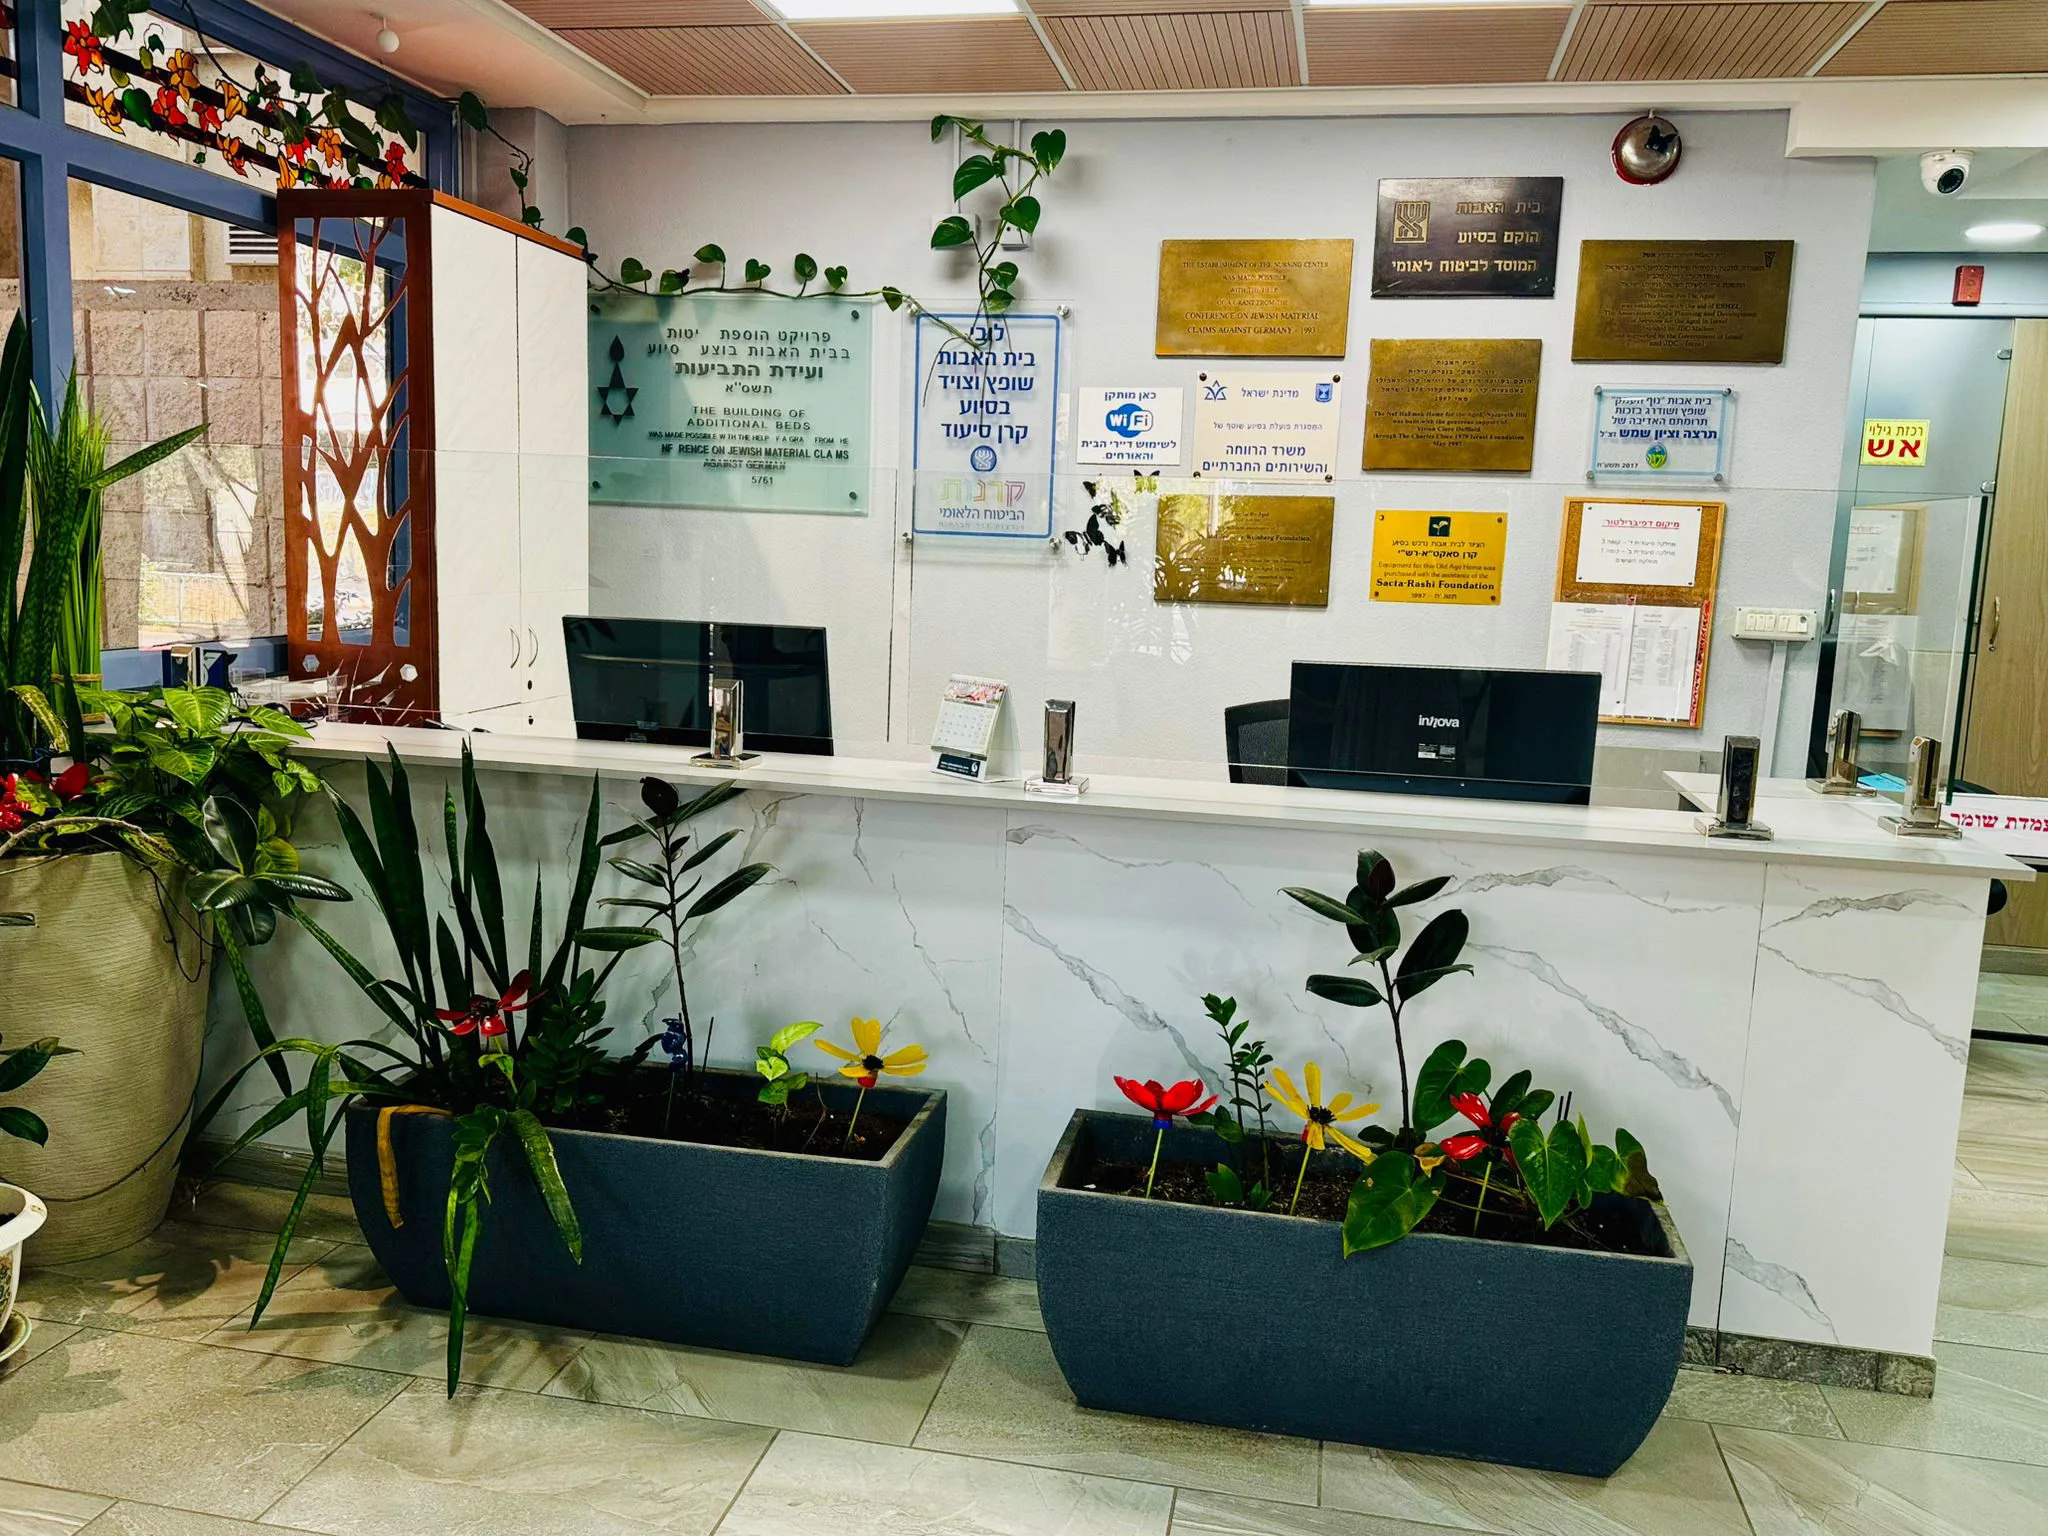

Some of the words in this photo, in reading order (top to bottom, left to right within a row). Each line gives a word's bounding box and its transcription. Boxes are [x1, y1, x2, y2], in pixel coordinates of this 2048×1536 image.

[1456, 202, 1504, 214] האבות
[1515, 202, 1541, 213] בית
[1458, 232, 1497, 243] בסיוע
[1504, 232, 1540, 244] הוקם
[1392, 260, 1432, 272] לאומי
[1439, 259, 1488, 272] לביטוח
[1494, 260, 1537, 271] המוסד
[1185, 312, 1235, 320] CONFERENCE
[1237, 312, 1248, 320] ON
[1250, 312, 1278, 320] JEWISH
[1281, 312, 1319, 320] MATERIAL
[667, 328, 698, 339] יטות
[720, 328, 769, 342] הוספת
[778, 331, 831, 345] פרויקט
[648, 344, 679, 355] סיוע
[701, 344, 738, 356] בוצע
[748, 346, 799, 358] האבות
[810, 348, 850, 359] בבית
[938, 351, 996, 366] האבות
[1003, 351, 1035, 366] בית
[675, 362, 760, 377] התביעות
[769, 364, 823, 379] ועידת
[725, 382, 772, 394] תשס"א
[938, 375, 980, 390] וצויד
[986, 375, 1034, 394] שופץ
[1105, 391, 1136, 402] מותקן
[1138, 392, 1156, 401] כאן
[1241, 387, 1269, 398] ישראל
[1272, 388, 1299, 398] מדינת
[1667, 397, 1692, 405] אבות
[1695, 397, 1712, 405] בית
[693, 406, 716, 415] THE
[724, 407, 782, 417] BUILDING
[789, 409, 806, 418] OF
[960, 400, 1010, 415] בסיוע
[1615, 407, 1642, 415] בזכות
[1645, 407, 1678, 415] ושודרג
[1681, 408, 1706, 416] שופץ
[687, 418, 768, 429] ADDITIONAL
[776, 421, 811, 430] BEDS
[1213, 421, 1223, 429] של
[1612, 416, 1626, 425] של
[1629, 417, 1666, 425] האדיבה
[1669, 418, 1708, 426] תרומתם
[941, 423, 991, 438] סיעוד
[998, 425, 1028, 443] קרן
[1620, 429, 1651, 438] שמש
[1654, 430, 1679, 440] וציון
[1683, 430, 1717, 439] תרצה
[1870, 423, 1891, 436] גילוי
[1896, 426, 1923, 436] רכזת
[665, 431, 684, 439] MADE
[752, 434, 769, 442] HELP
[1081, 440, 1107, 448] הבית
[1110, 440, 1133, 448] דיירי
[1136, 440, 1176, 449] לשימוש
[1868, 439, 1920, 457] אש
[712, 445, 725, 455] ON
[727, 446, 762, 456] JEWISH
[764, 447, 811, 458] MATERIAL
[1105, 451, 1153, 460] והאורחים
[1226, 445, 1267, 455] הרווחה
[1272, 446, 1306, 456] משרד
[1202, 461, 1261, 472] החברתיים
[1265, 462, 1327, 473] והשירותים
[751, 476, 774, 484] 5761
[941, 478, 1025, 507] קרנות
[940, 506, 980, 519] הלאומי
[984, 509, 1024, 520] הביטוח
[1656, 521, 1680, 529] מיקום
[1463, 551, 1478, 559] קרן
[1376, 579, 1435, 588] Sacta-Rashi
[1439, 580, 1495, 590] Foundation
[1951, 813, 1998, 828] שומר
